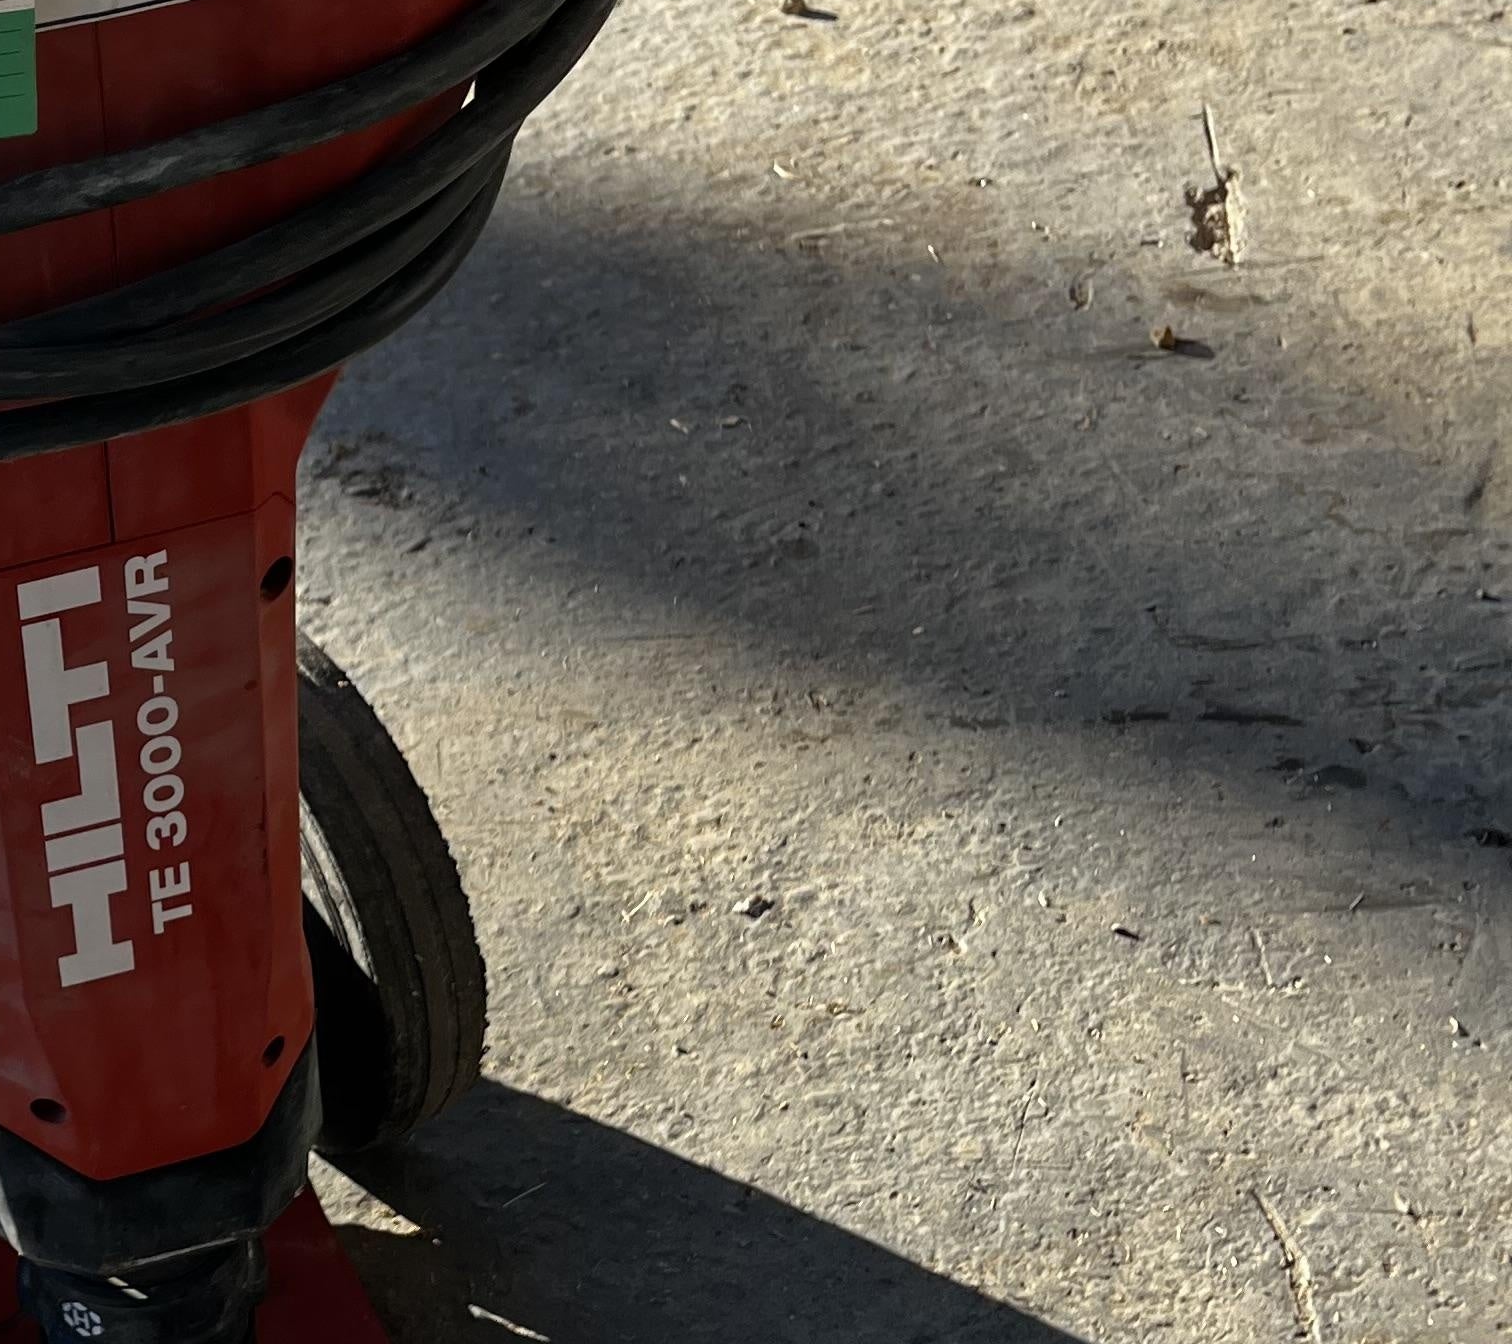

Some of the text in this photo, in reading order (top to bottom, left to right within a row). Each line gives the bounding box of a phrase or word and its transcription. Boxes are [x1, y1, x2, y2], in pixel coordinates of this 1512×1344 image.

[17, 565, 135, 988] HILTI
[124, 549, 193, 935] TE 3000-AVR
